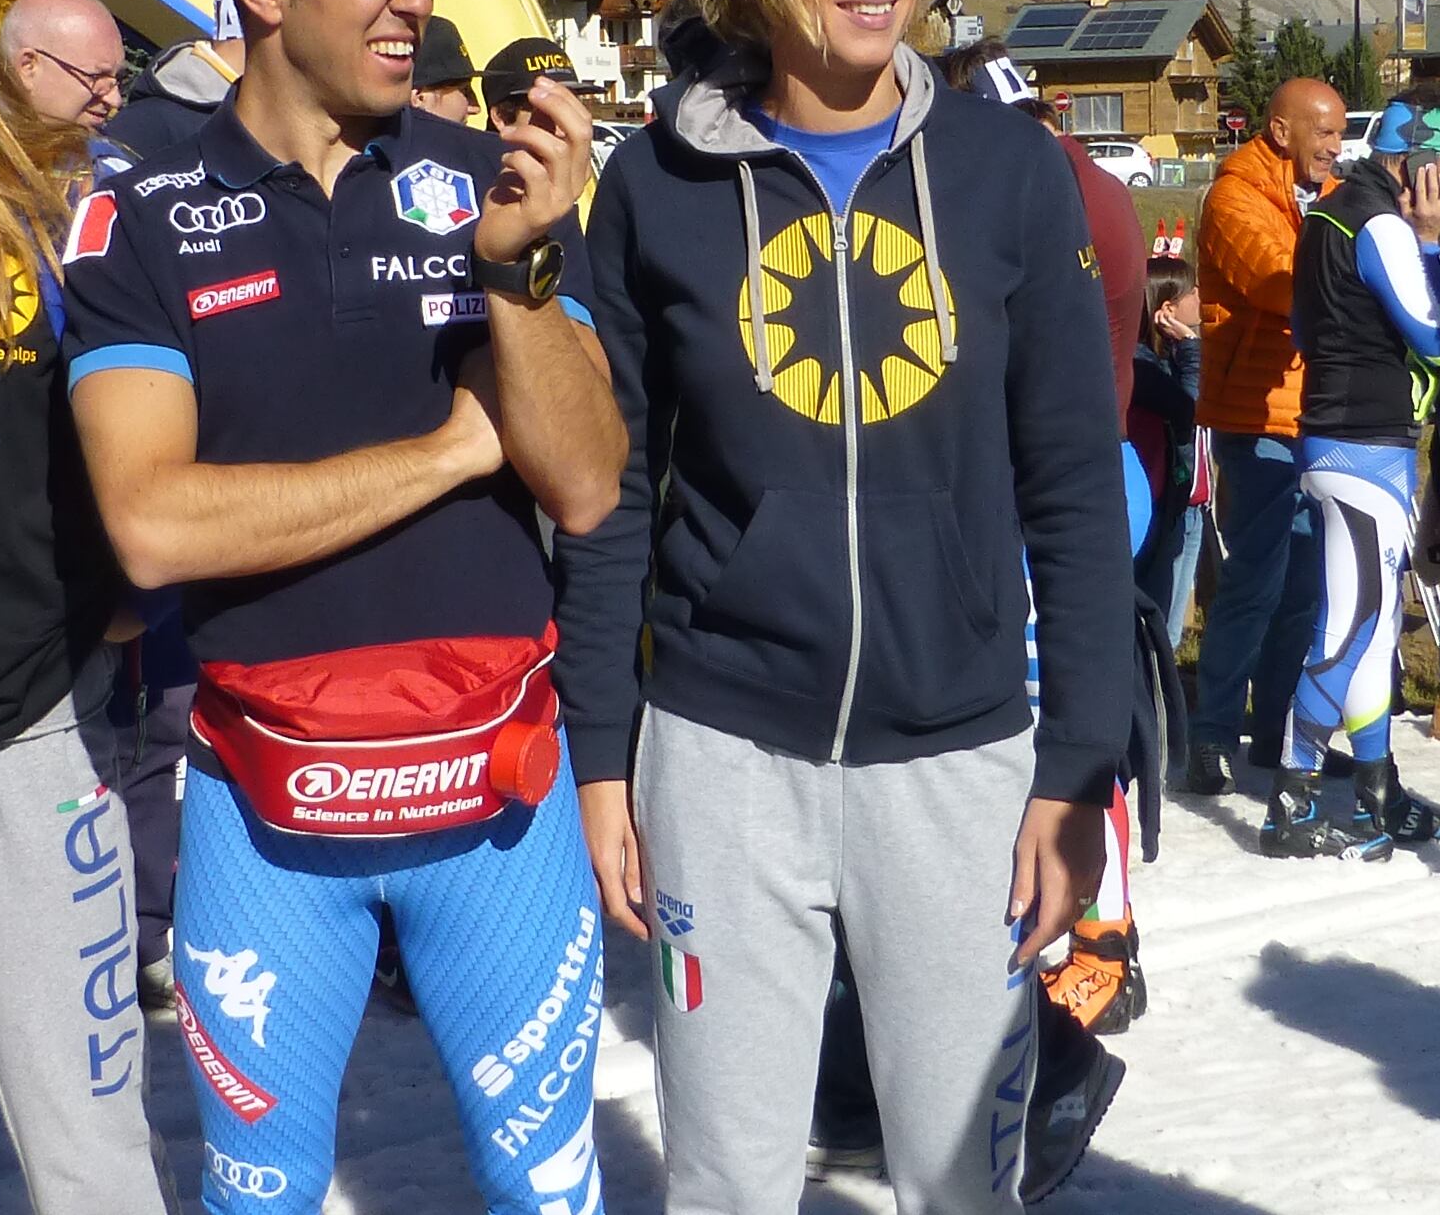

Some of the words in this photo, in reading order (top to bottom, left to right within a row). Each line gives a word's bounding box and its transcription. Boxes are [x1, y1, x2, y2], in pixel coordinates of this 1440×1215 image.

[134, 161, 206, 196] Kapp
[179, 239, 222, 255] Audi
[217, 277, 276, 306] ENERVIT
[428, 297, 486, 317] POLIZI
[347, 752, 488, 800] ENERVIT
[292, 806, 369, 823] Science
[399, 795, 484, 820] Nutrition
[656, 889, 694, 919] arena
[65, 801, 138, 1097] ITALIA
[502, 905, 596, 1065] sportful
[188, 1032, 268, 1112] ENERVIT
